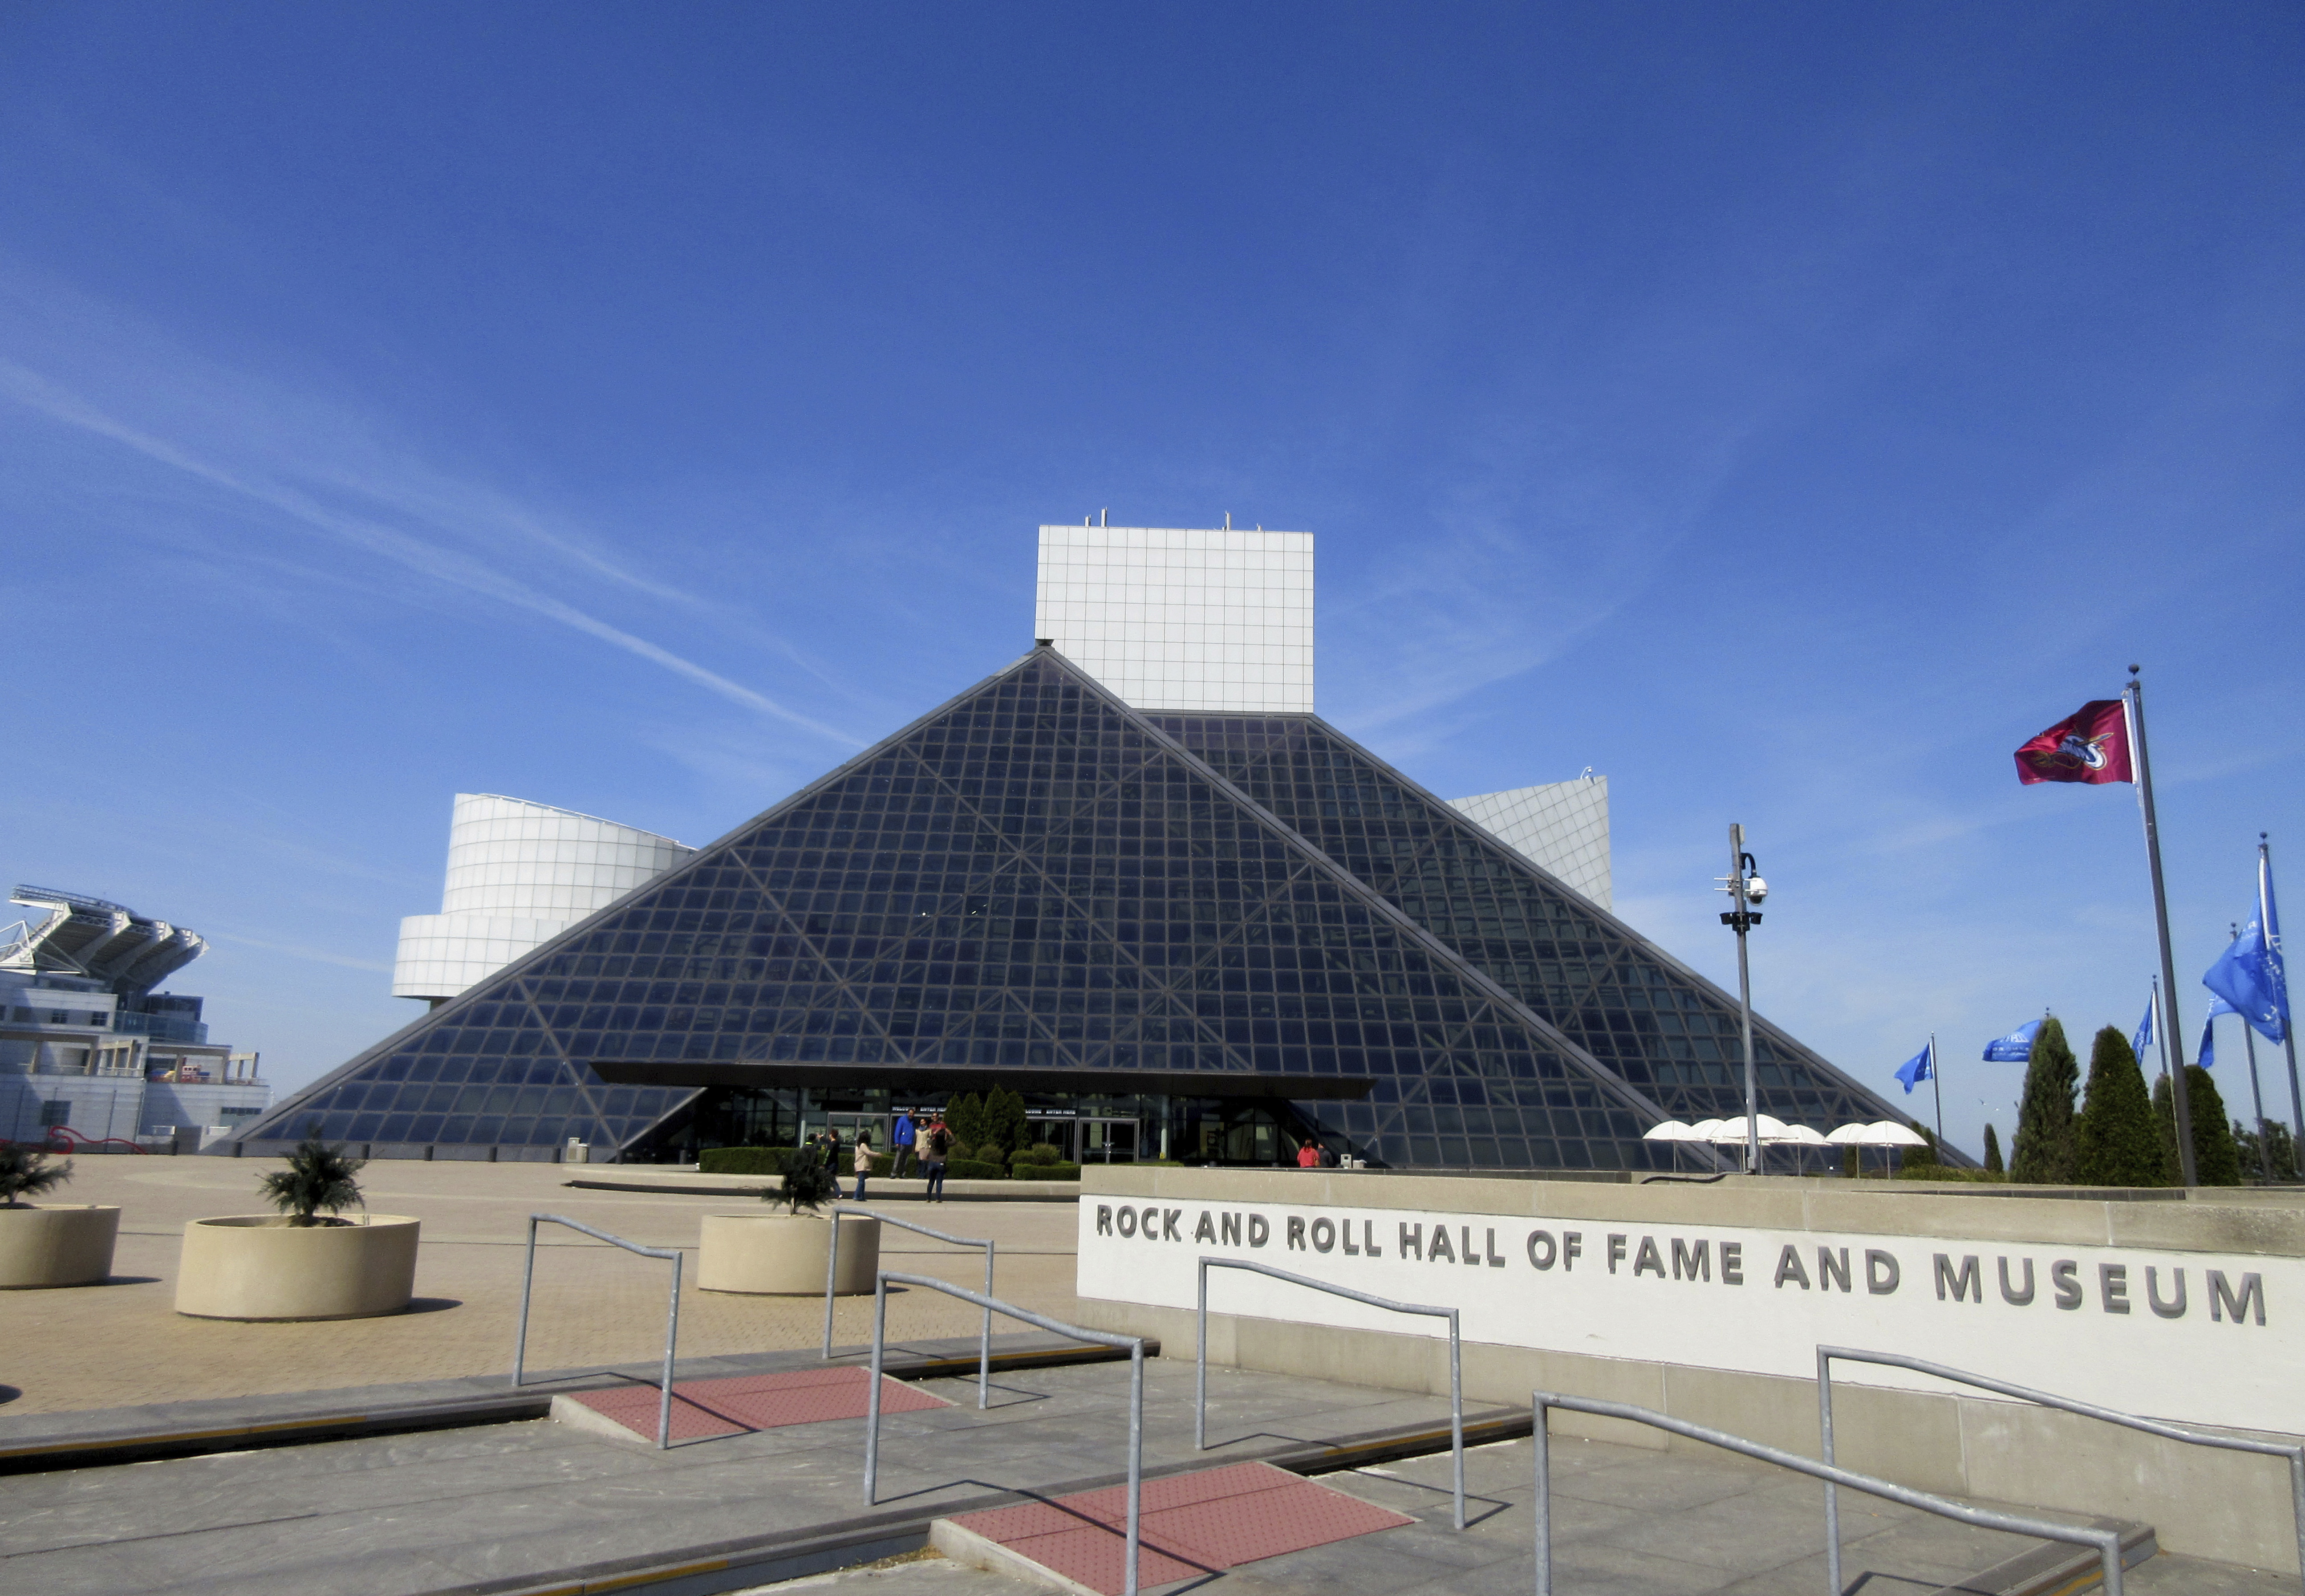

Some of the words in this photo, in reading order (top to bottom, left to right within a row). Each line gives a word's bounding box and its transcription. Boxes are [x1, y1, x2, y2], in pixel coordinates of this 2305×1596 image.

[1096, 1204, 1182, 1242] ROCK
[1194, 1210, 1270, 1248] AND
[1287, 1216, 1382, 1257] ROLL
[1399, 1222, 1506, 1268] HALL
[1526, 1230, 1582, 1272] OF
[1607, 1234, 1744, 1286] FAME
[1774, 1244, 1900, 1295] AND
[1932, 1253, 2267, 1327] MUSEUM
